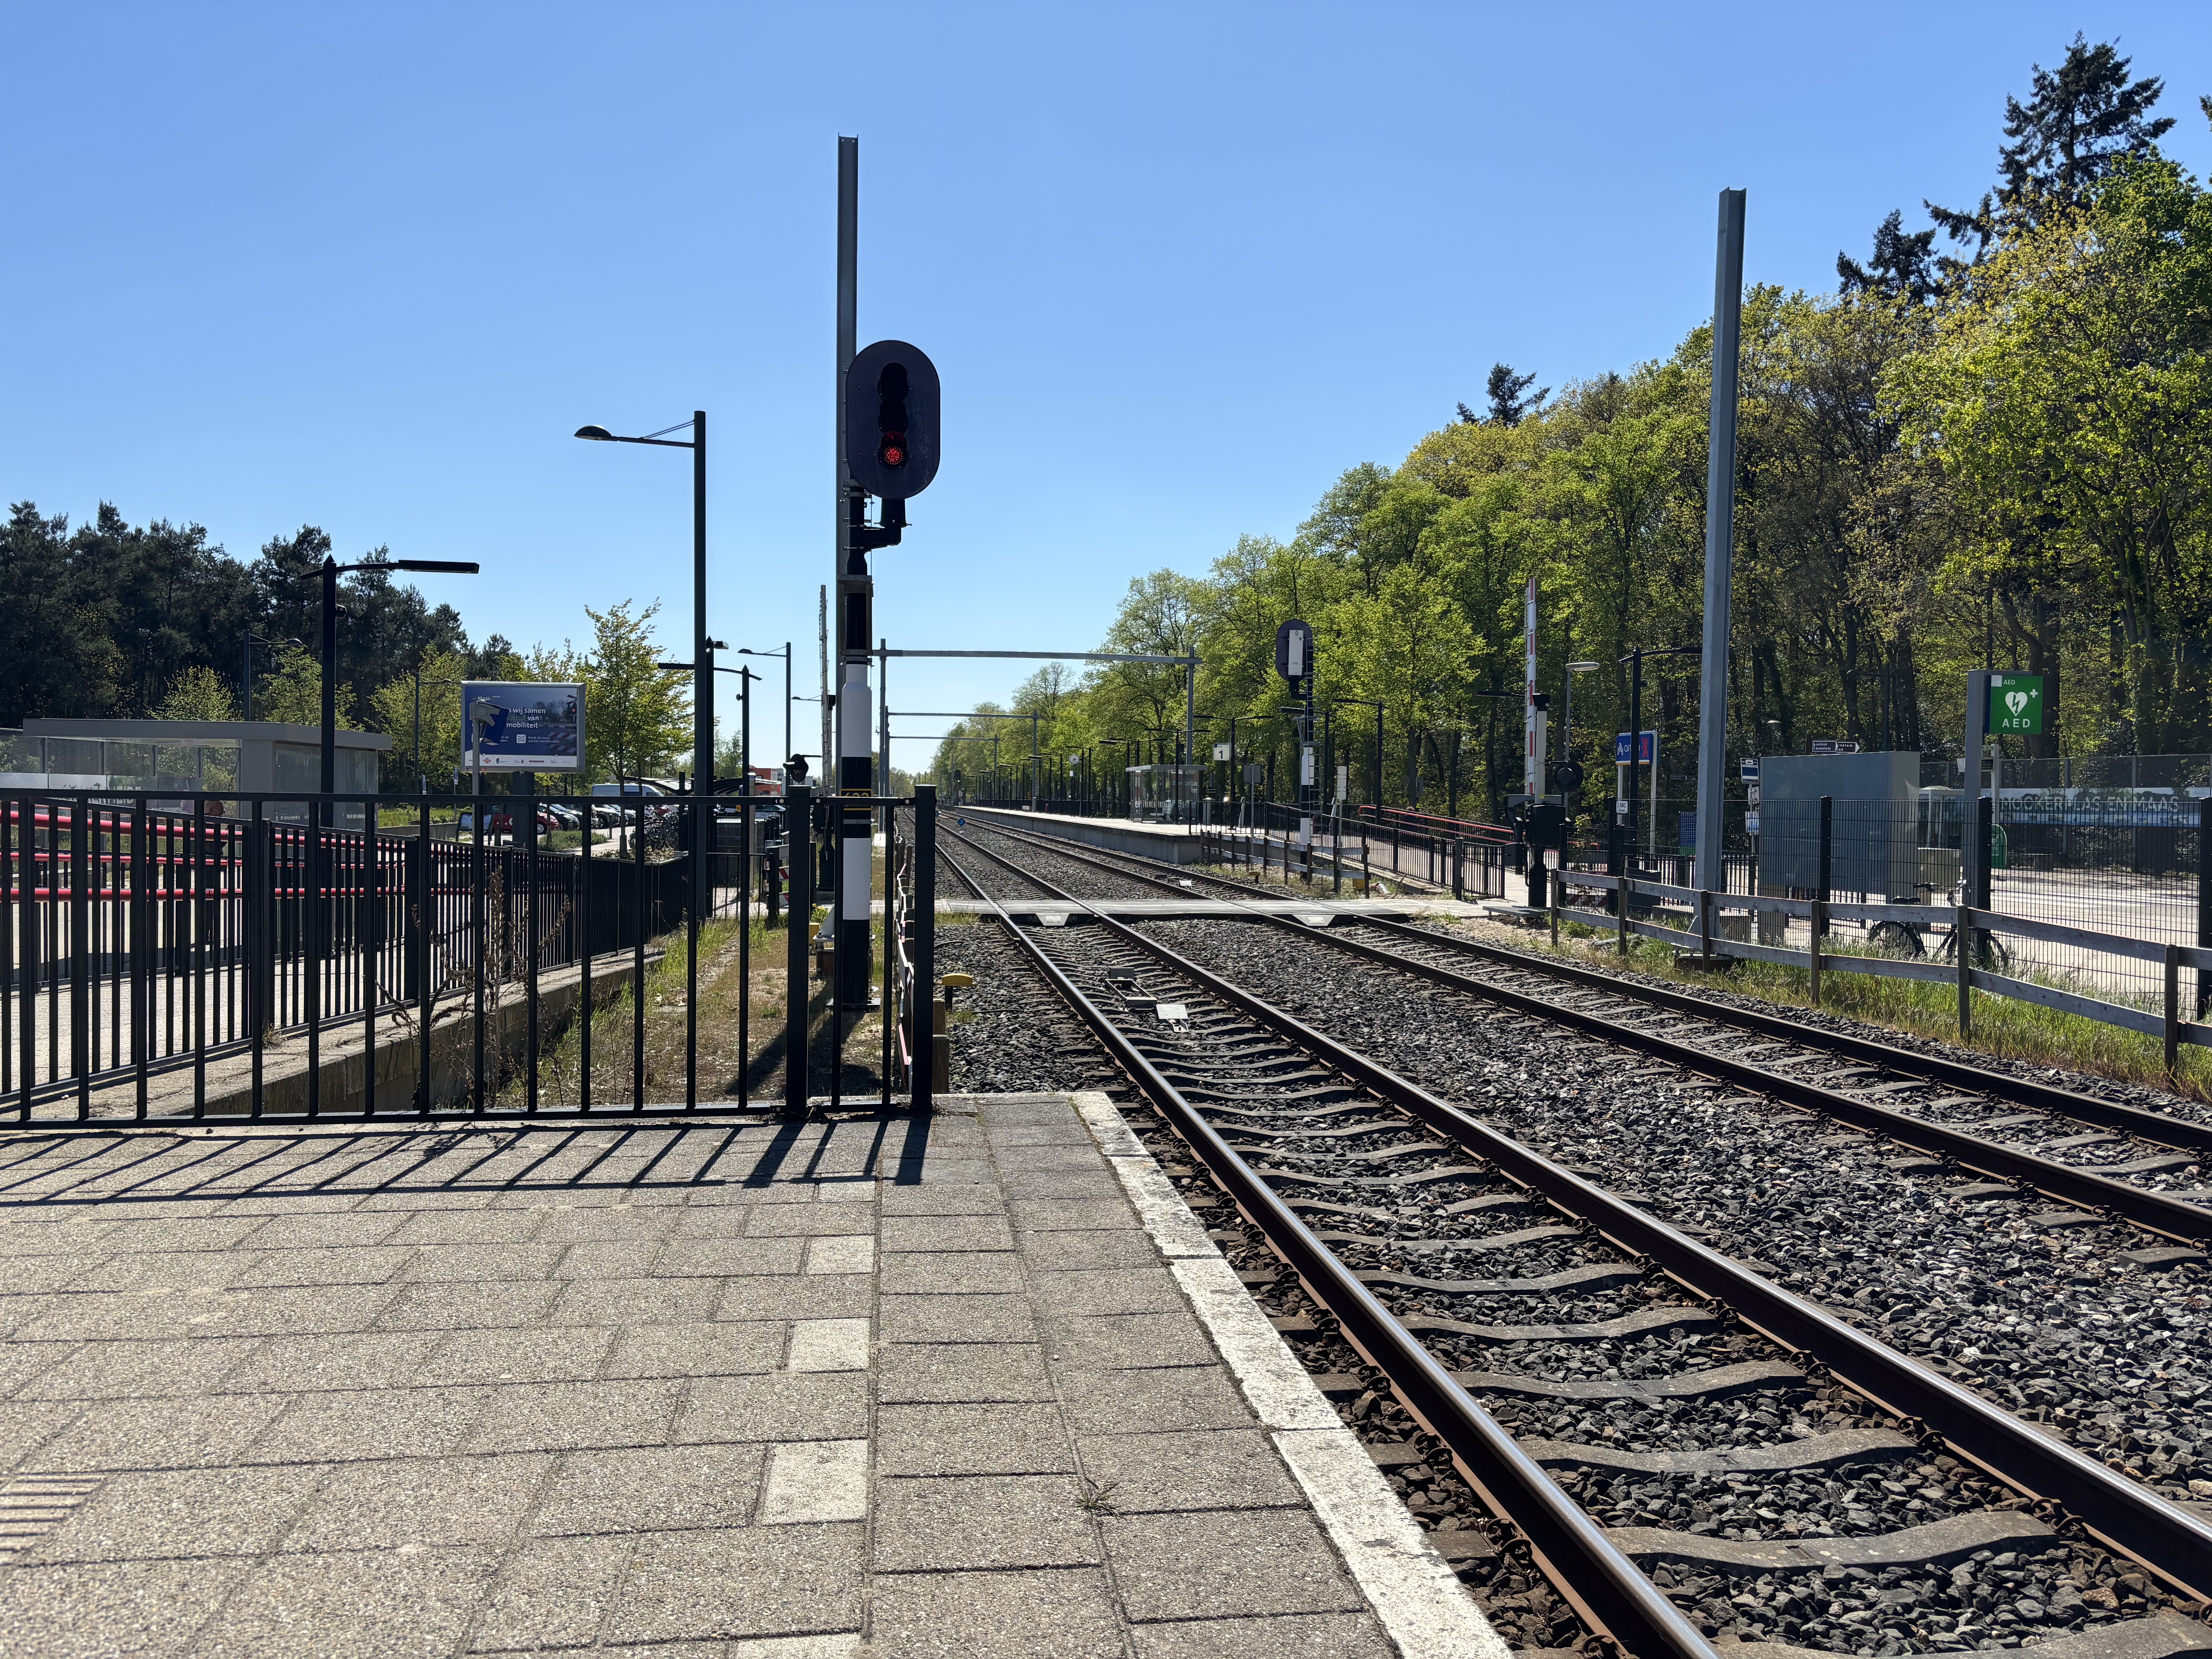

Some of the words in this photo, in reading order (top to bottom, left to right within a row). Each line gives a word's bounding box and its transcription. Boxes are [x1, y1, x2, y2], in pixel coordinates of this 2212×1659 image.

[2002, 718, 2030, 728] AED
[1219, 750, 1223, 759] 1
[2107, 796, 2127, 812] EN
[2133, 796, 2179, 812] MAAS
